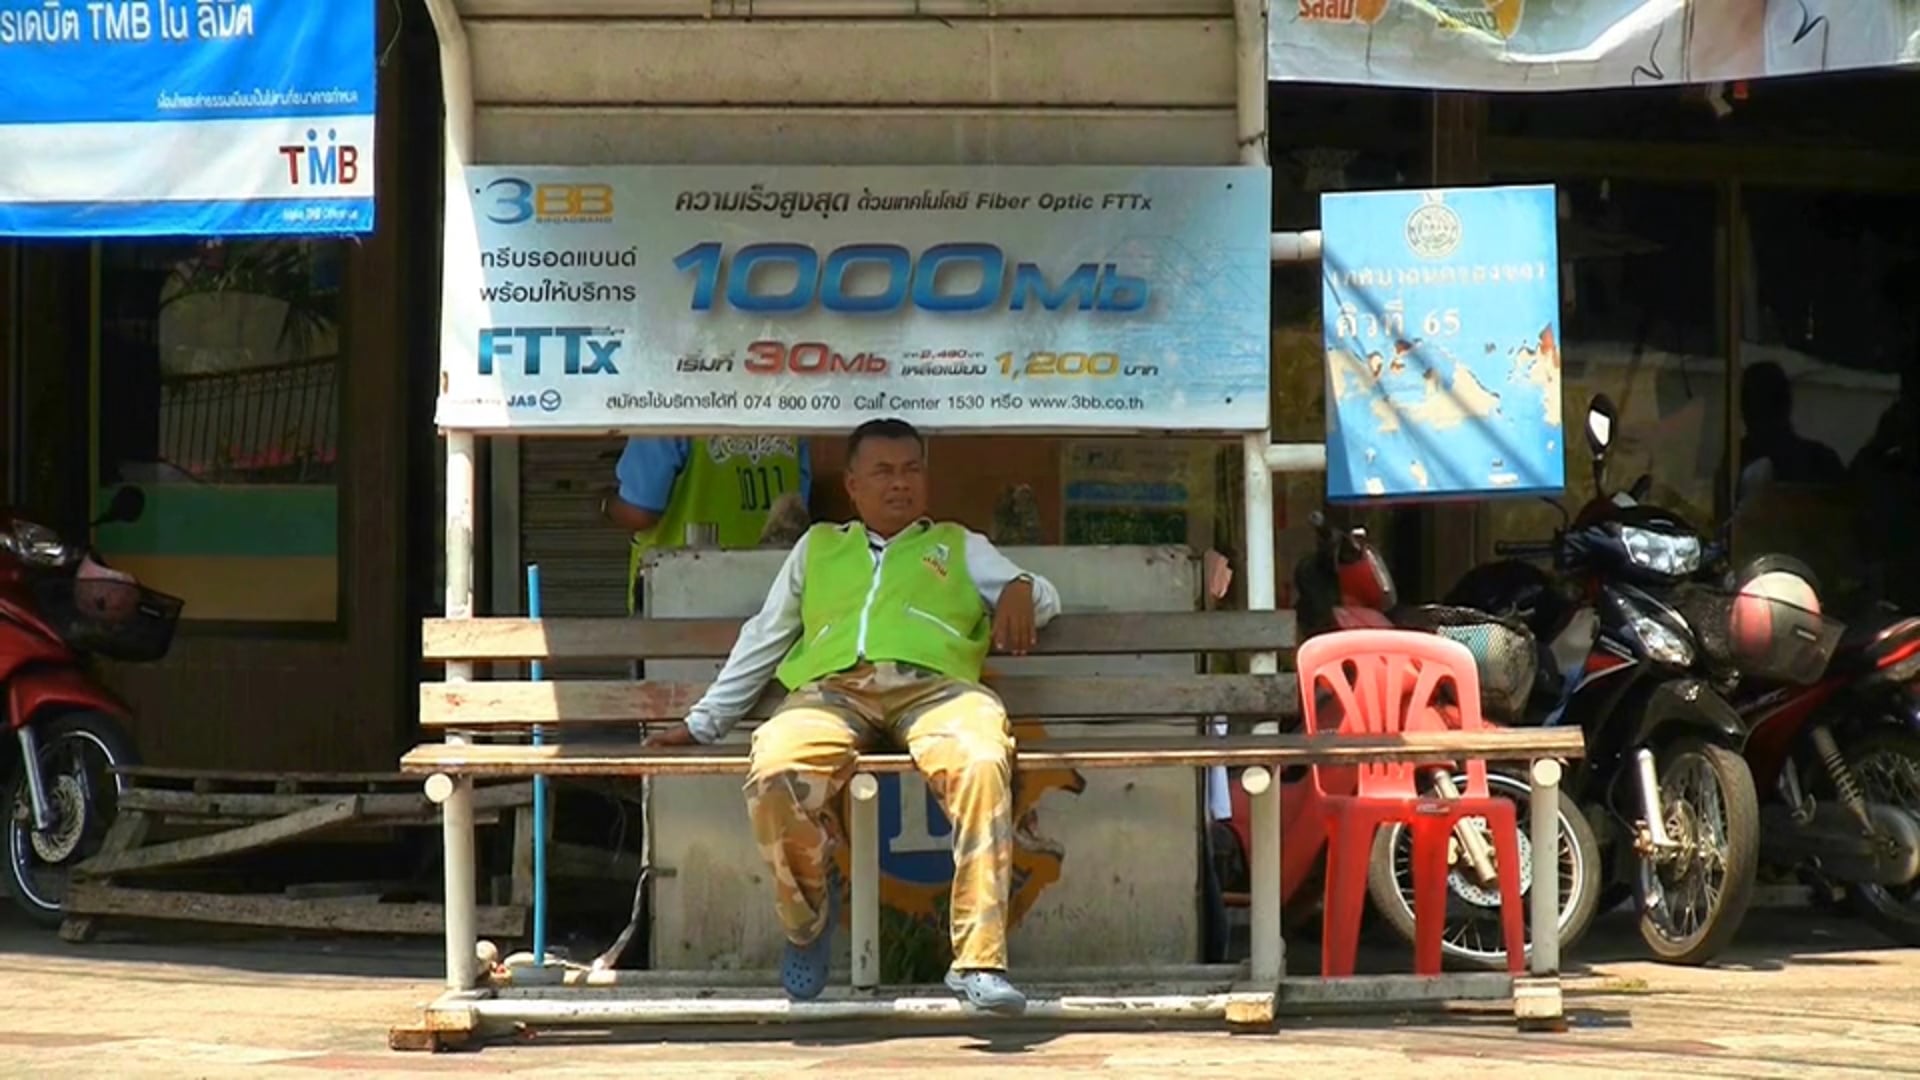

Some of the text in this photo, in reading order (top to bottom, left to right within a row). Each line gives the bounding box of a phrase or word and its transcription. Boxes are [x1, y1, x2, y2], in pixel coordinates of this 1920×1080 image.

[87, 3, 152, 40] TMB
[279, 145, 358, 185] TMB
[486, 177, 614, 225] 3BB
[675, 184, 1152, 219] ความเร็วสูงสุด ด้วยเทคโนโลยี Fiber Optic FTTx
[480, 246, 638, 268] ทรีบรอดแบนด์
[479, 279, 637, 303] พร้อมให้บริการ
[1423, 309, 1461, 336] 65
[478, 326, 622, 375] FTTx
[994, 351, 1121, 381] 1,200
[1123, 365, 1159, 376] บาท
[507, 395, 536, 407] JAS
[605, 391, 1145, 411] สมัครใช้บริการได้ที่ 074 800 070 Call Center 1530 หรือ www.3bb.co.th
